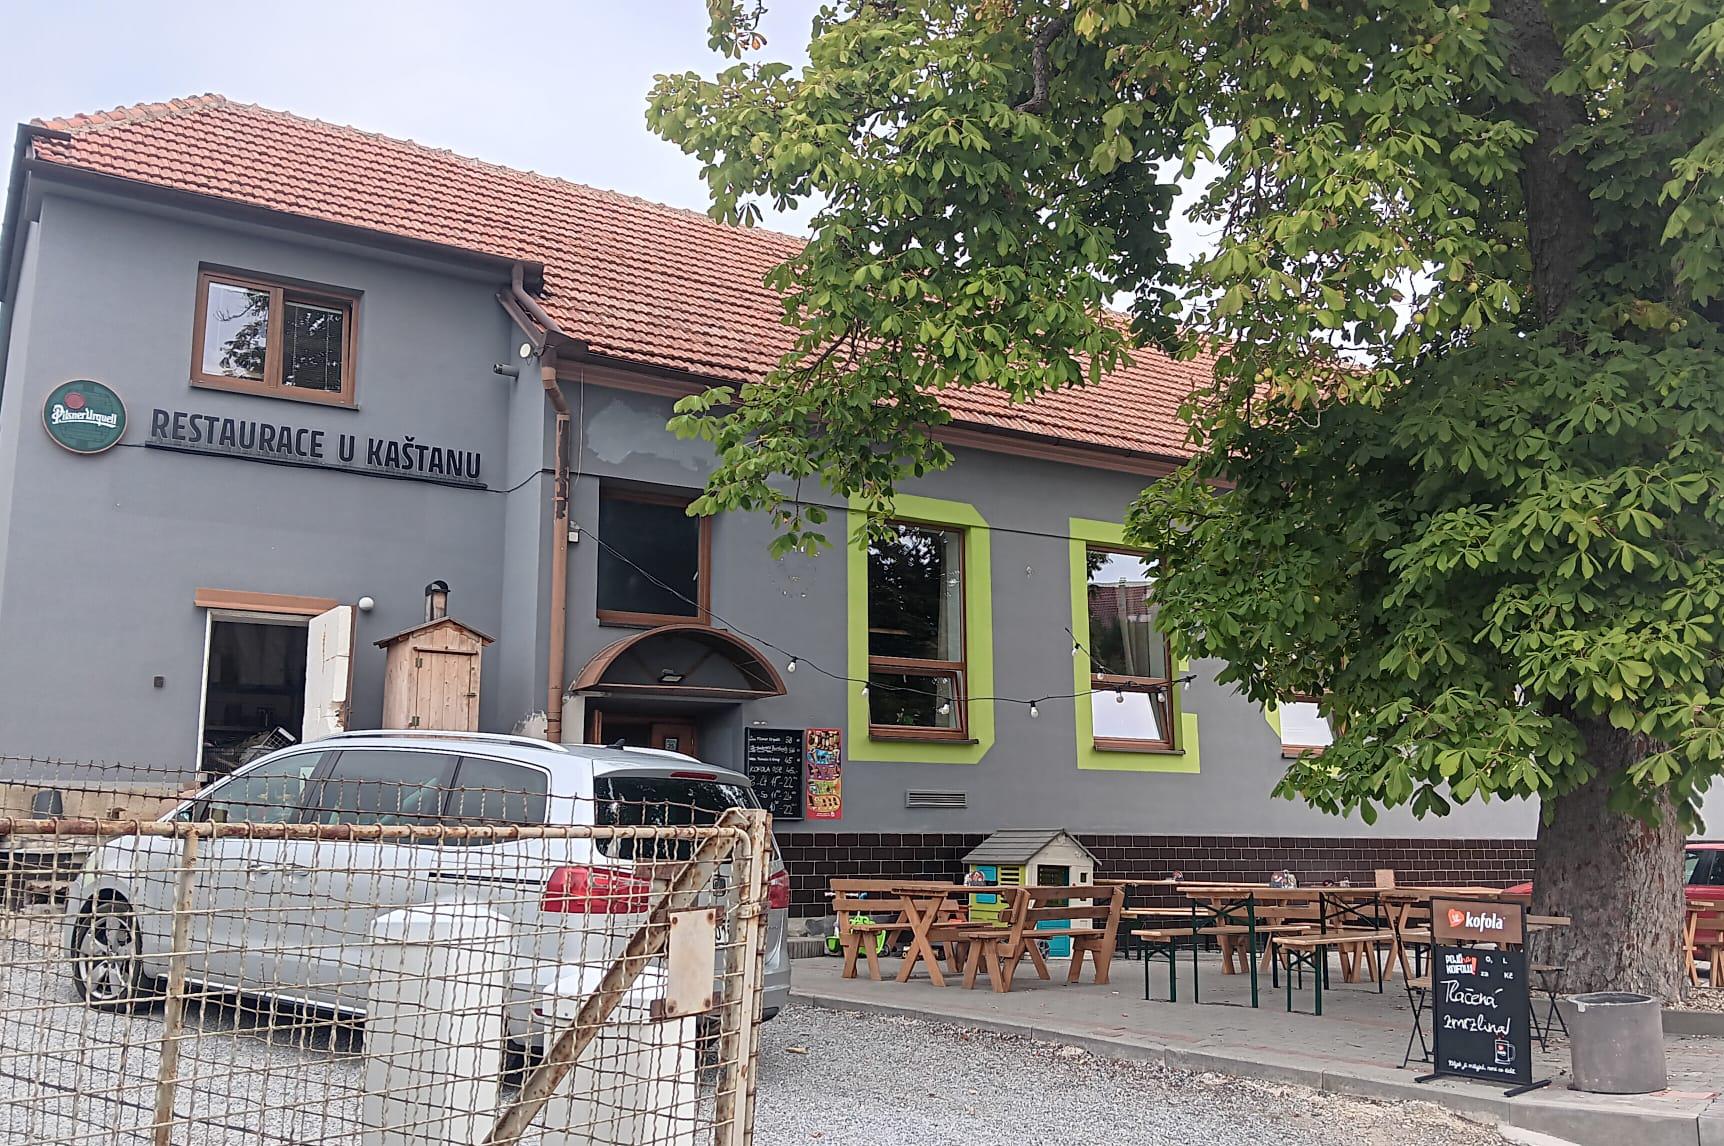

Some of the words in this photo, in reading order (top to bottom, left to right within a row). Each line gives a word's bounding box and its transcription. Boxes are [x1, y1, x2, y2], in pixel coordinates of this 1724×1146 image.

[51, 404, 86, 424] Pilsner
[85, 408, 118, 427] Urquell
[151, 408, 325, 459] RESTAURACE
[338, 434, 355, 462] U
[367, 435, 481, 479] KAŠTANU
[1465, 911, 1504, 933] kofola
